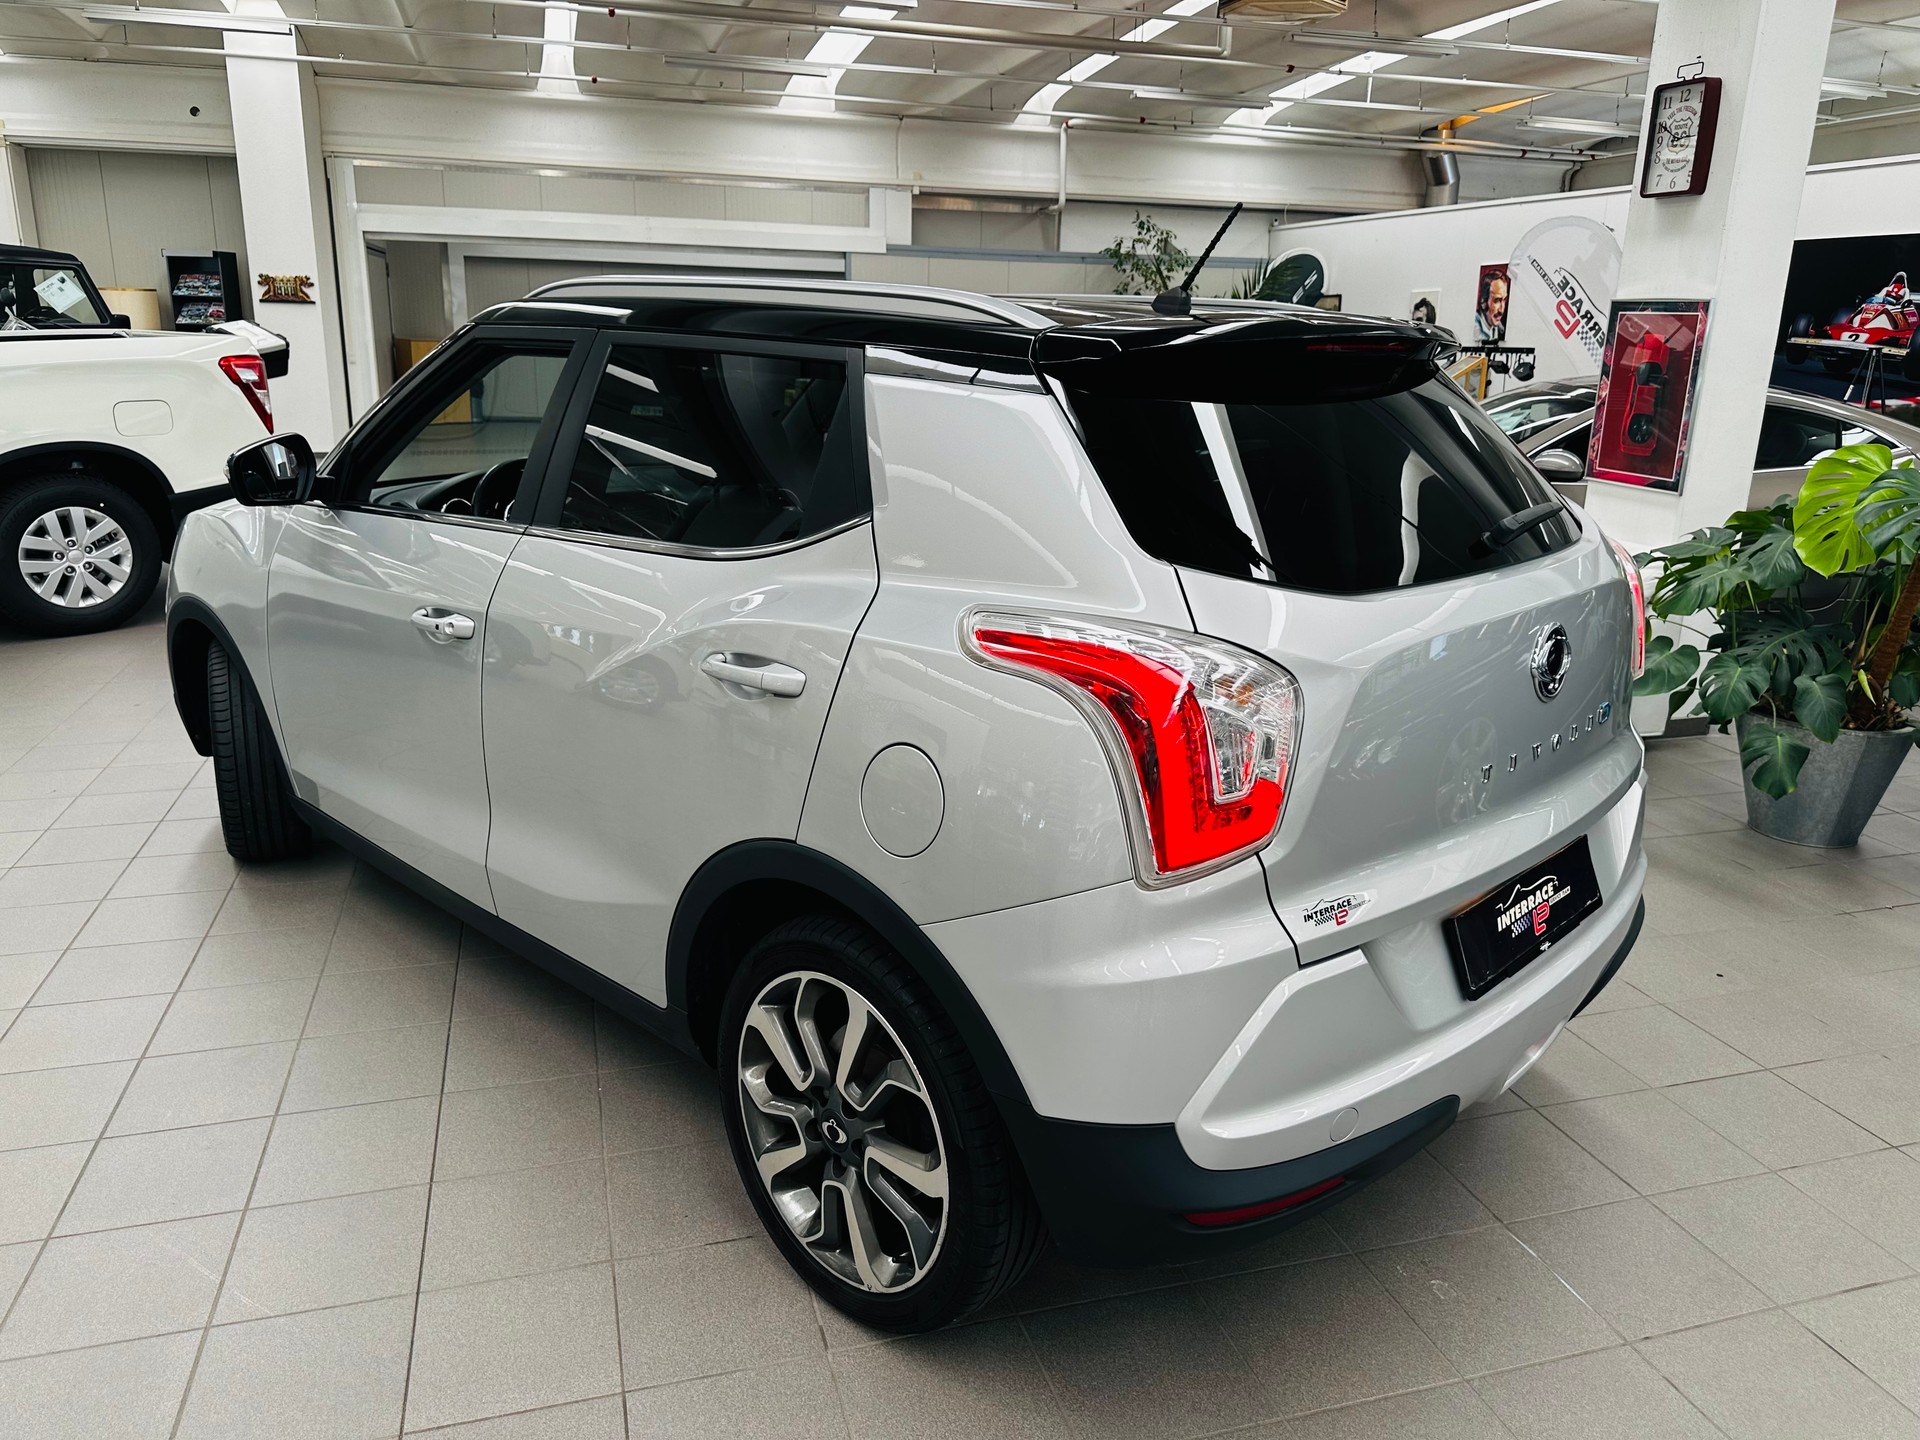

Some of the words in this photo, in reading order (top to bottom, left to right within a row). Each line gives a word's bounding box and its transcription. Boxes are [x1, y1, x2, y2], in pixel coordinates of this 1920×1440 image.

[1662, 96, 1673, 110] 11
[1679, 88, 1692, 104] 12
[1656, 120, 1667, 135] 10
[1674, 122, 1689, 131] ROUTE
[1656, 135, 1664, 149] 9
[1653, 150, 1662, 165] 8
[1655, 174, 1663, 187] 7
[1669, 176, 1677, 190] 6
[1303, 898, 1352, 923] INTERRACE
[1497, 882, 1555, 932] INTERRACE
